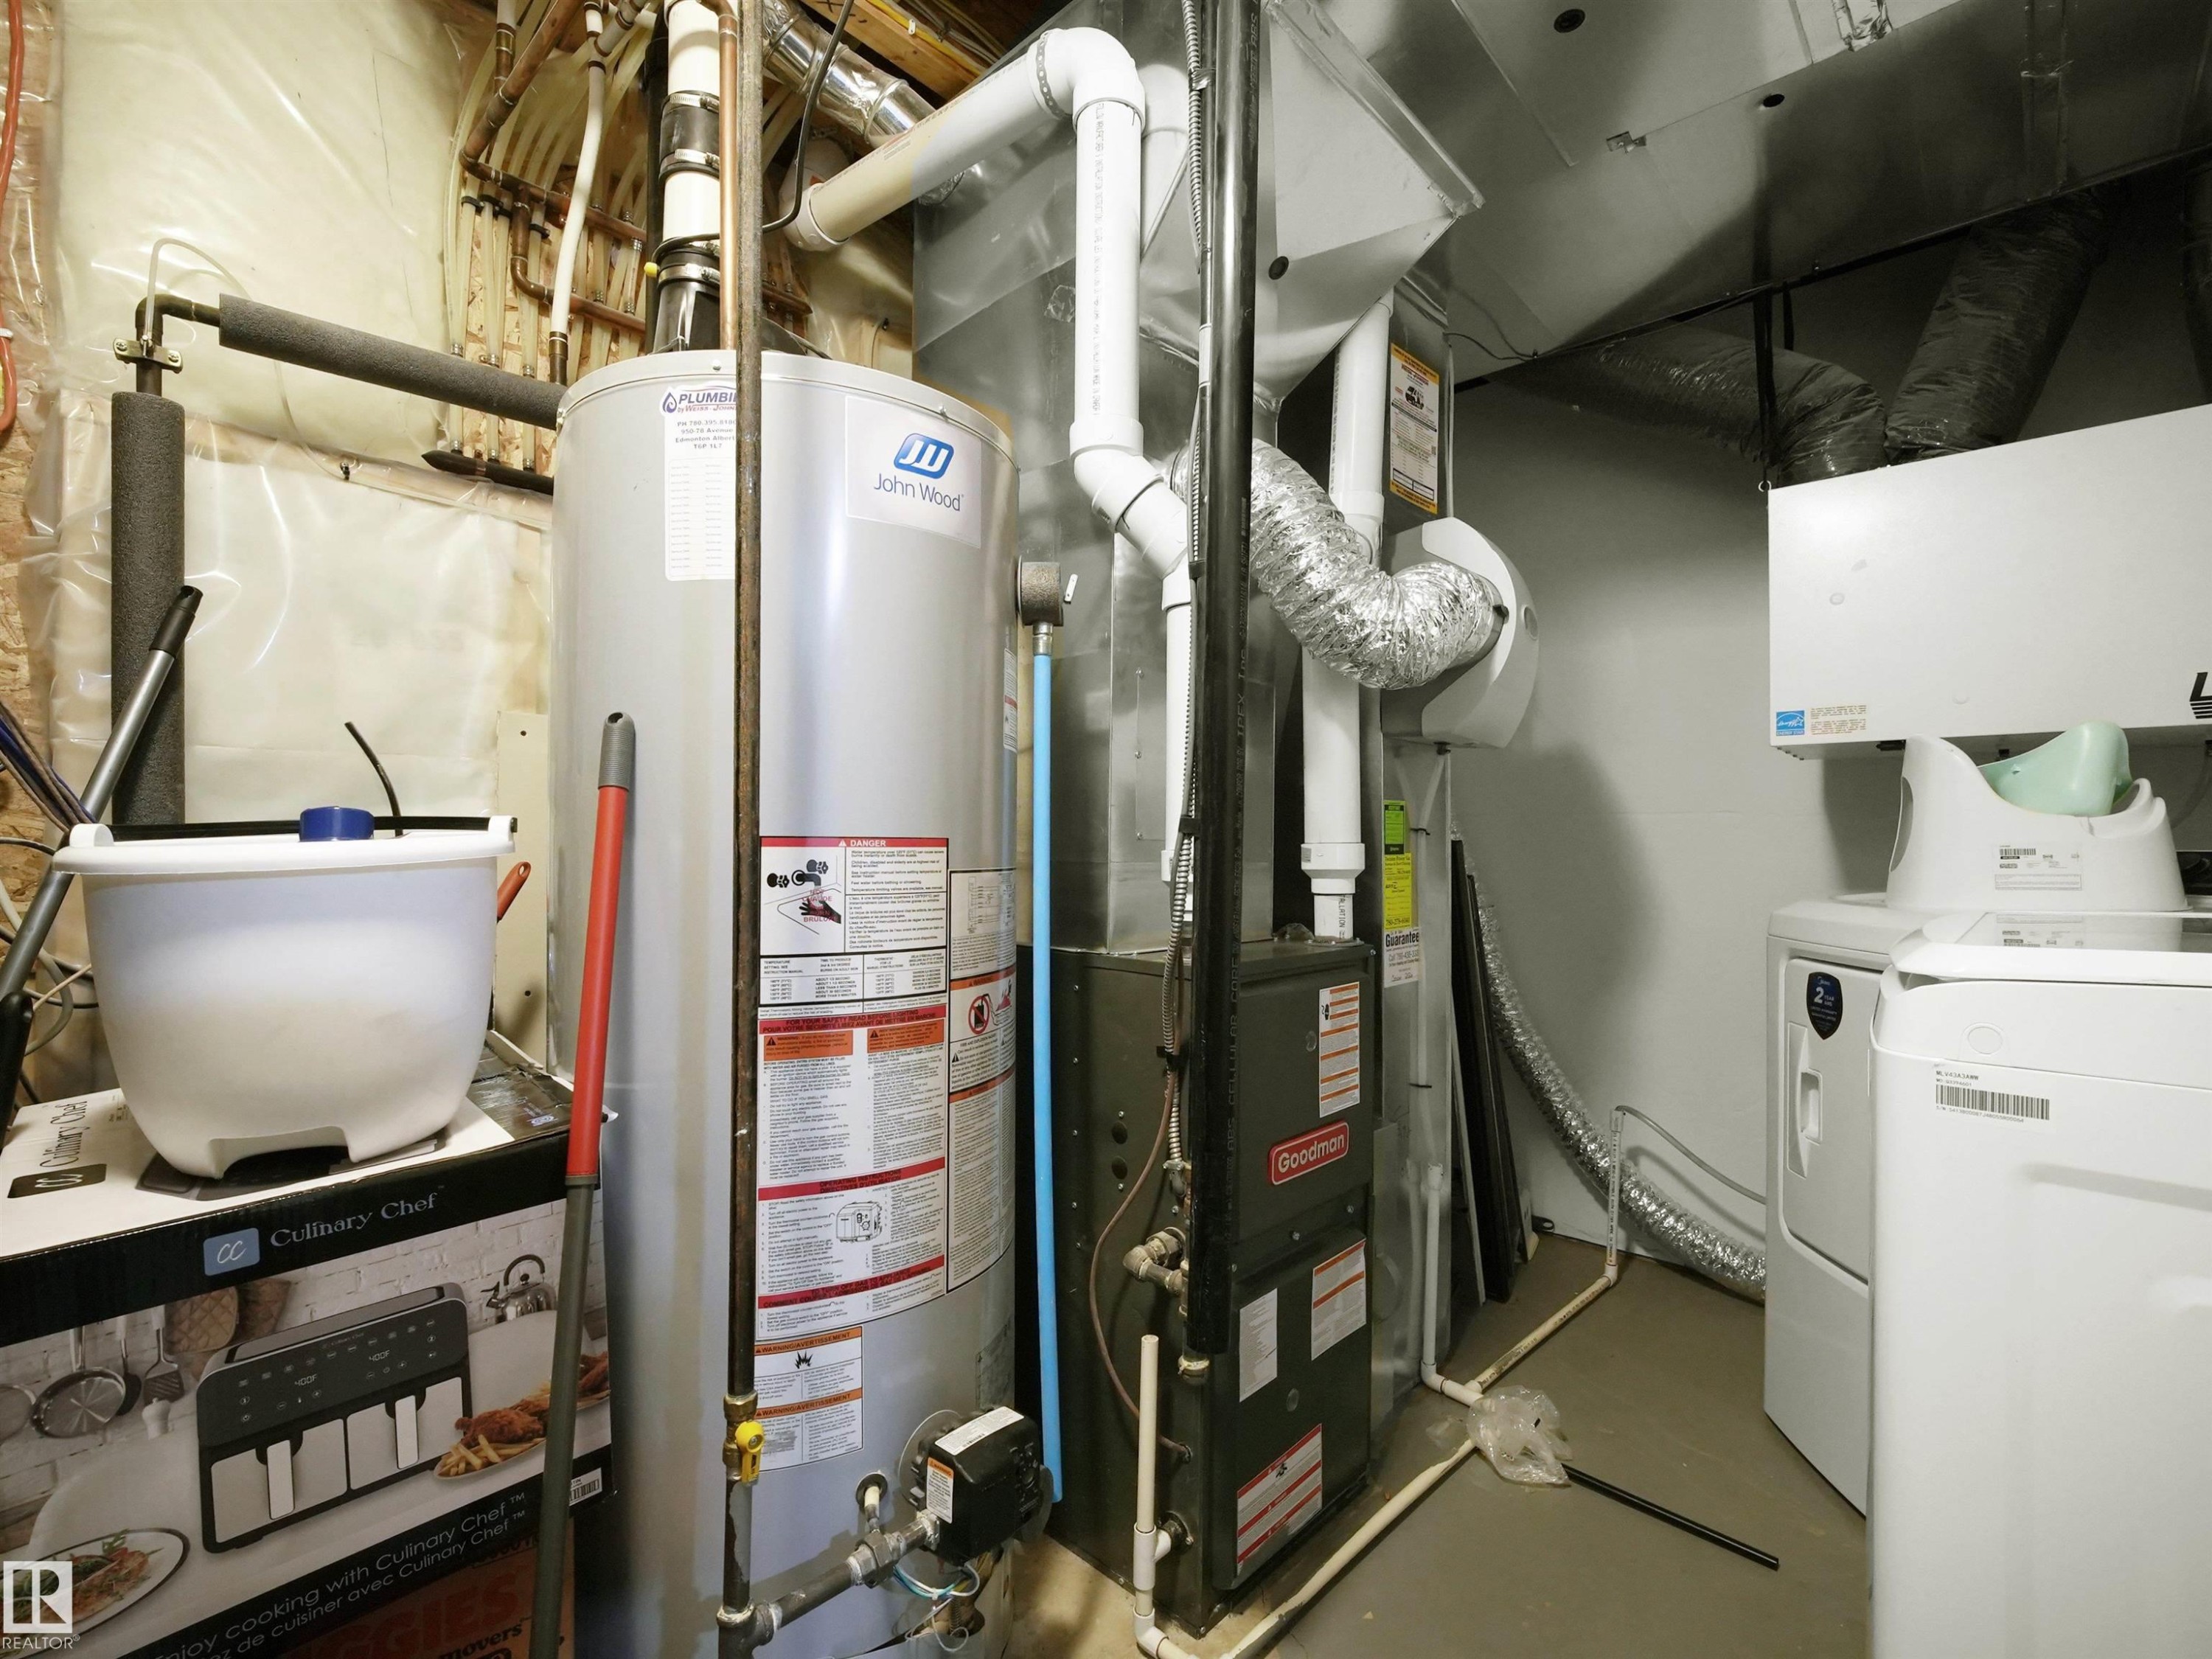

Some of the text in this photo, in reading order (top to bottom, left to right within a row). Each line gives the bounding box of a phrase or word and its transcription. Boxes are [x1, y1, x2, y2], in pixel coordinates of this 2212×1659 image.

[874, 473, 915, 498] John
[1814, 987, 1825, 1004] 2
[50, 1101, 88, 1125] Chef
[39, 1127, 91, 1167] Culinary
[1278, 1132, 1344, 1173] Goodman
[271, 1211, 372, 1247] Culinary
[380, 1192, 438, 1220] Chef
[762, 1332, 851, 1353] WARNING/AVERTISSEMENT
[762, 1394, 851, 1416] WARNING/AVERTISSEMENT
[226, 1588, 319, 1640] cooking
[325, 1565, 369, 1592] with
[376, 1527, 456, 1571] Culinary
[461, 1502, 507, 1532] Chef
[237, 1633, 265, 1654] de
[271, 1596, 344, 1638] cuisiner
[347, 1574, 394, 1601] avec
[399, 1540, 467, 1578] Culinary
[470, 1517, 509, 1545] Chef
